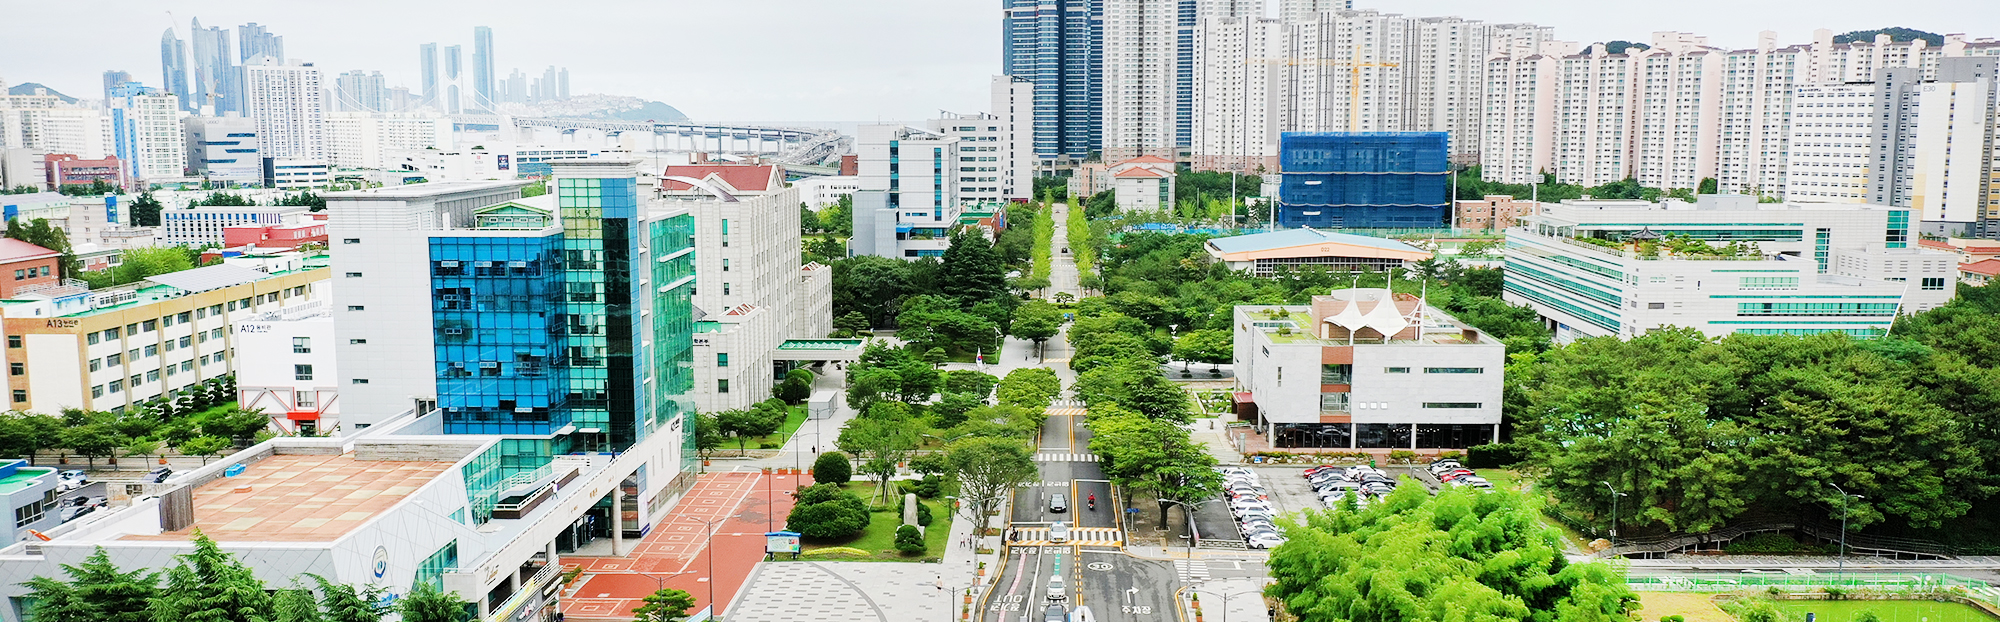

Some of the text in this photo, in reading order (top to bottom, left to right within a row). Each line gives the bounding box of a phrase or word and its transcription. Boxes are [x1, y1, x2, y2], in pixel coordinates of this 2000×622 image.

[46, 319, 63, 327] A13
[240, 324, 255, 333] A12
[1044, 546, 1071, 555] 일반권
[993, 594, 1023, 603] OUT
[1121, 604, 1152, 614] 주차장
